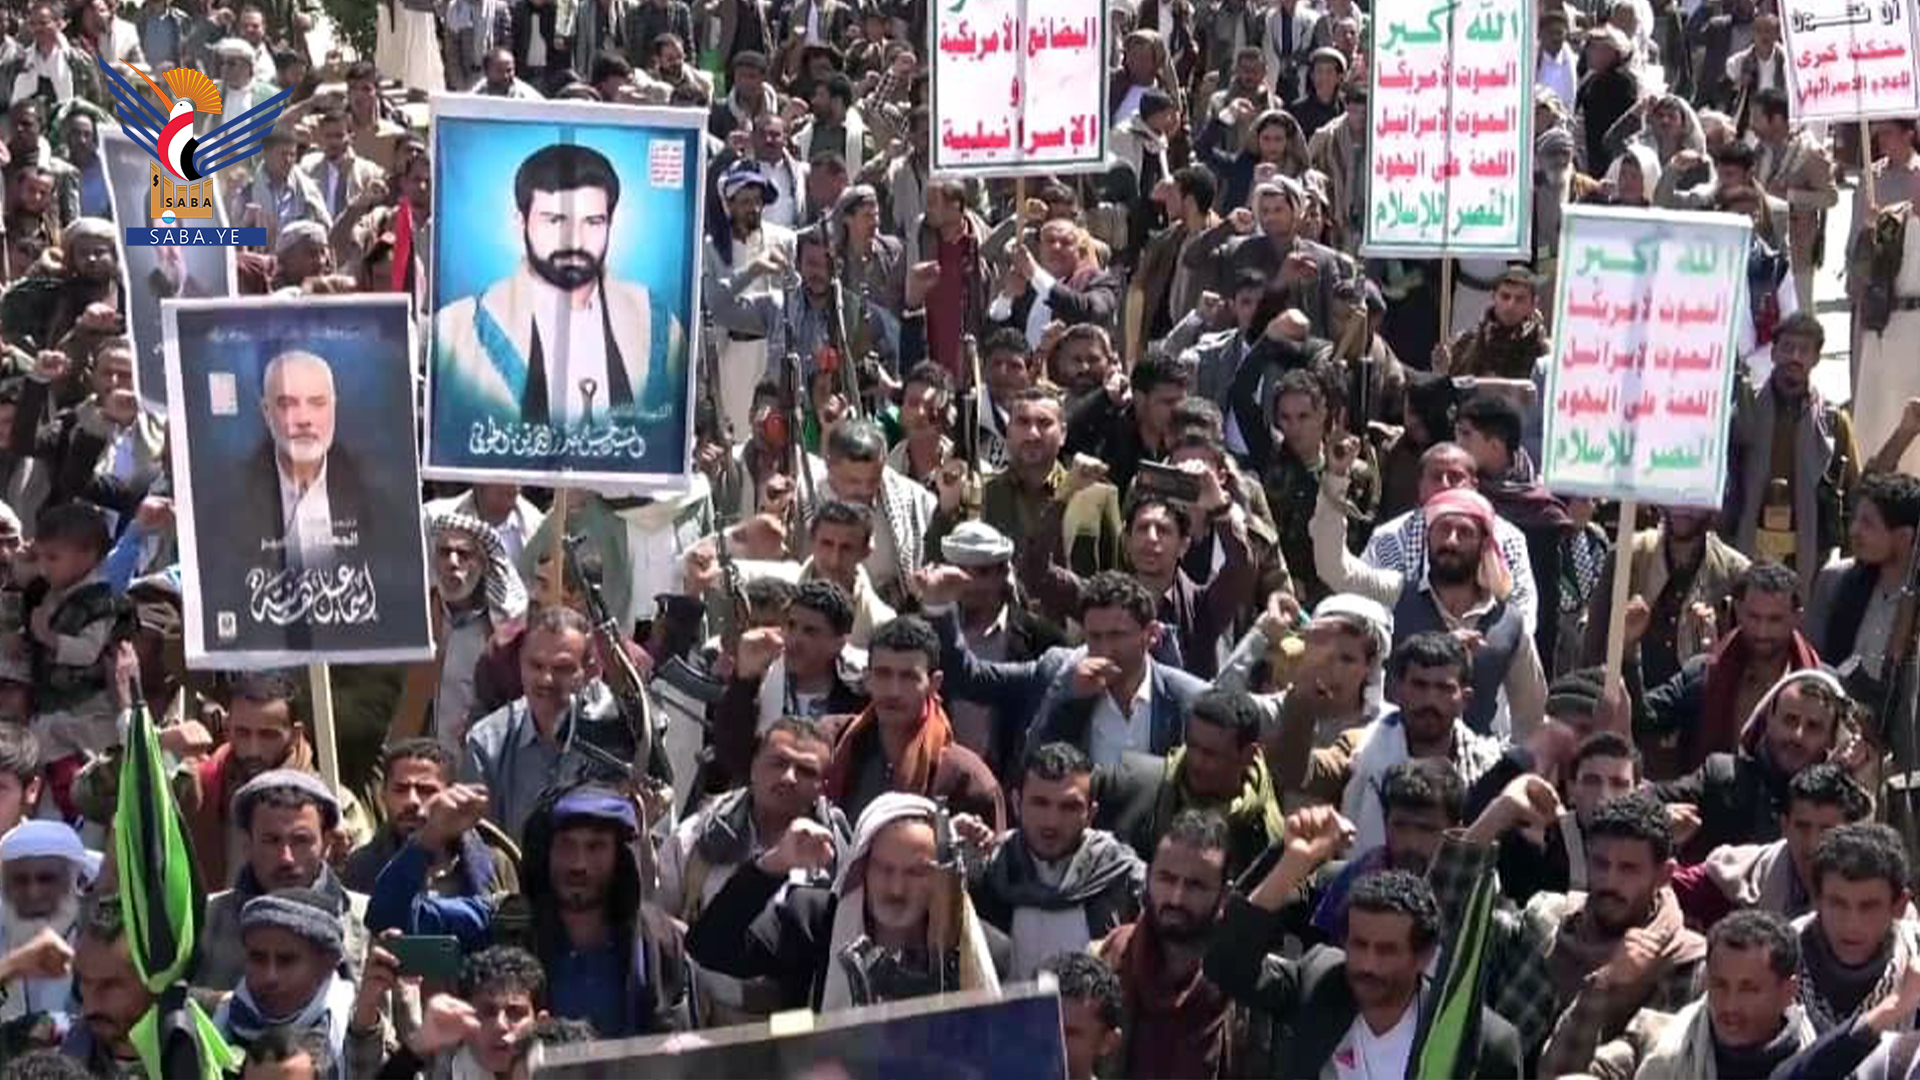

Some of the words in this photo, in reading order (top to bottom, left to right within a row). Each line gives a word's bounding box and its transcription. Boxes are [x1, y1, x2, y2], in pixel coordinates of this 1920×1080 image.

[940, 12, 1020, 61] الأمريكية
[1027, 15, 1097, 58] البضائع
[1466, 1, 1519, 41] الله
[1010, 75, 1020, 108] و
[1455, 63, 1517, 94] الموت
[943, 114, 1096, 159] الإسرائيلية
[1455, 105, 1517, 138] الموت
[1375, 149, 1425, 183] اليهود
[1431, 151, 1461, 182] على
[1468, 149, 1516, 178] اللعنة
[1452, 187, 1514, 235] النصر
[1676, 236, 1735, 281] الله
[1659, 292, 1727, 326] الموت
[1654, 341, 1722, 377] الموت
[1557, 384, 1617, 418] اليهود
[1624, 388, 1656, 421] على
[1665, 388, 1718, 420] اللعنة
[1644, 436, 1714, 475] النصر
[245, 565, 316, 625] هنية
